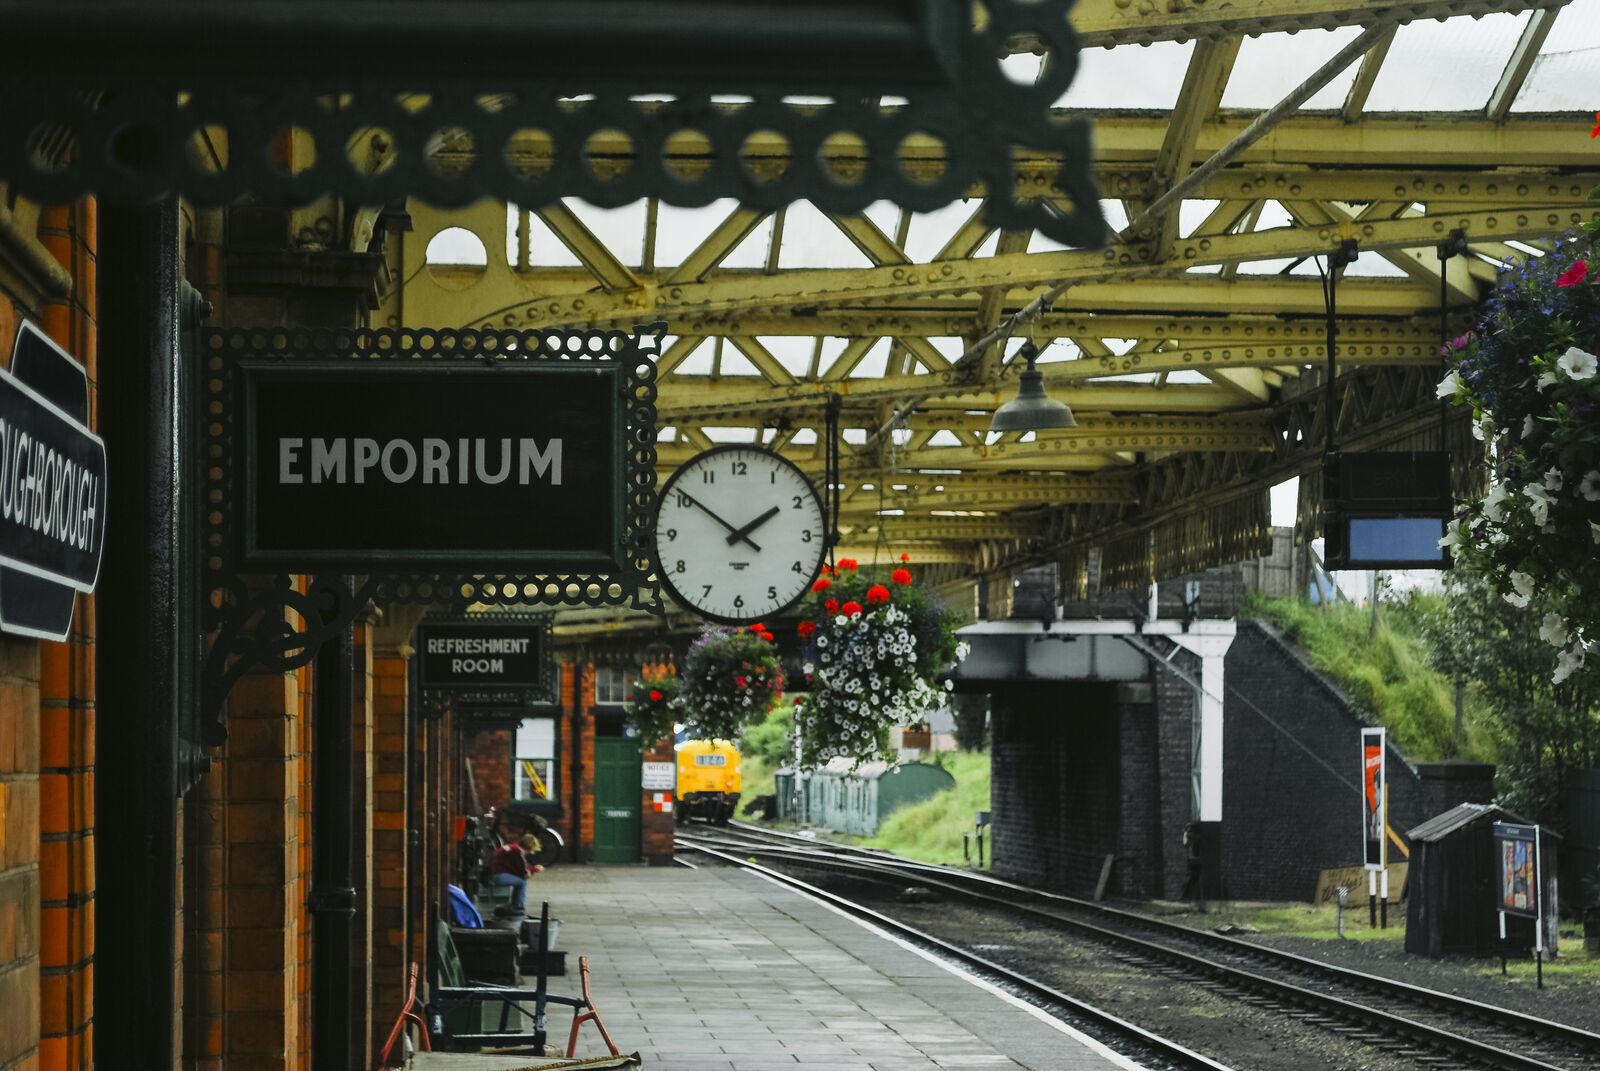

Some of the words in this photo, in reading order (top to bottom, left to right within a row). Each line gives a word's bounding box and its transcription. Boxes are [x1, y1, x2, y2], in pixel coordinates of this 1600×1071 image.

[279, 438, 563, 485] EMPORIUM
[732, 462, 747, 476] 12
[703, 471, 715, 484] 11
[770, 471, 775, 485] 1
[677, 495, 693, 508] 10
[792, 496, 803, 509] 2
[667, 529, 677, 541] 9
[801, 530, 812, 543] 3
[676, 560, 686, 573] 8
[791, 561, 802, 574] 4
[702, 585, 712, 598] 7
[768, 586, 777, 599] 5
[734, 595, 744, 608] 6
[428, 638, 529, 654] REFRESHMENT
[452, 658, 504, 673] ROOM
